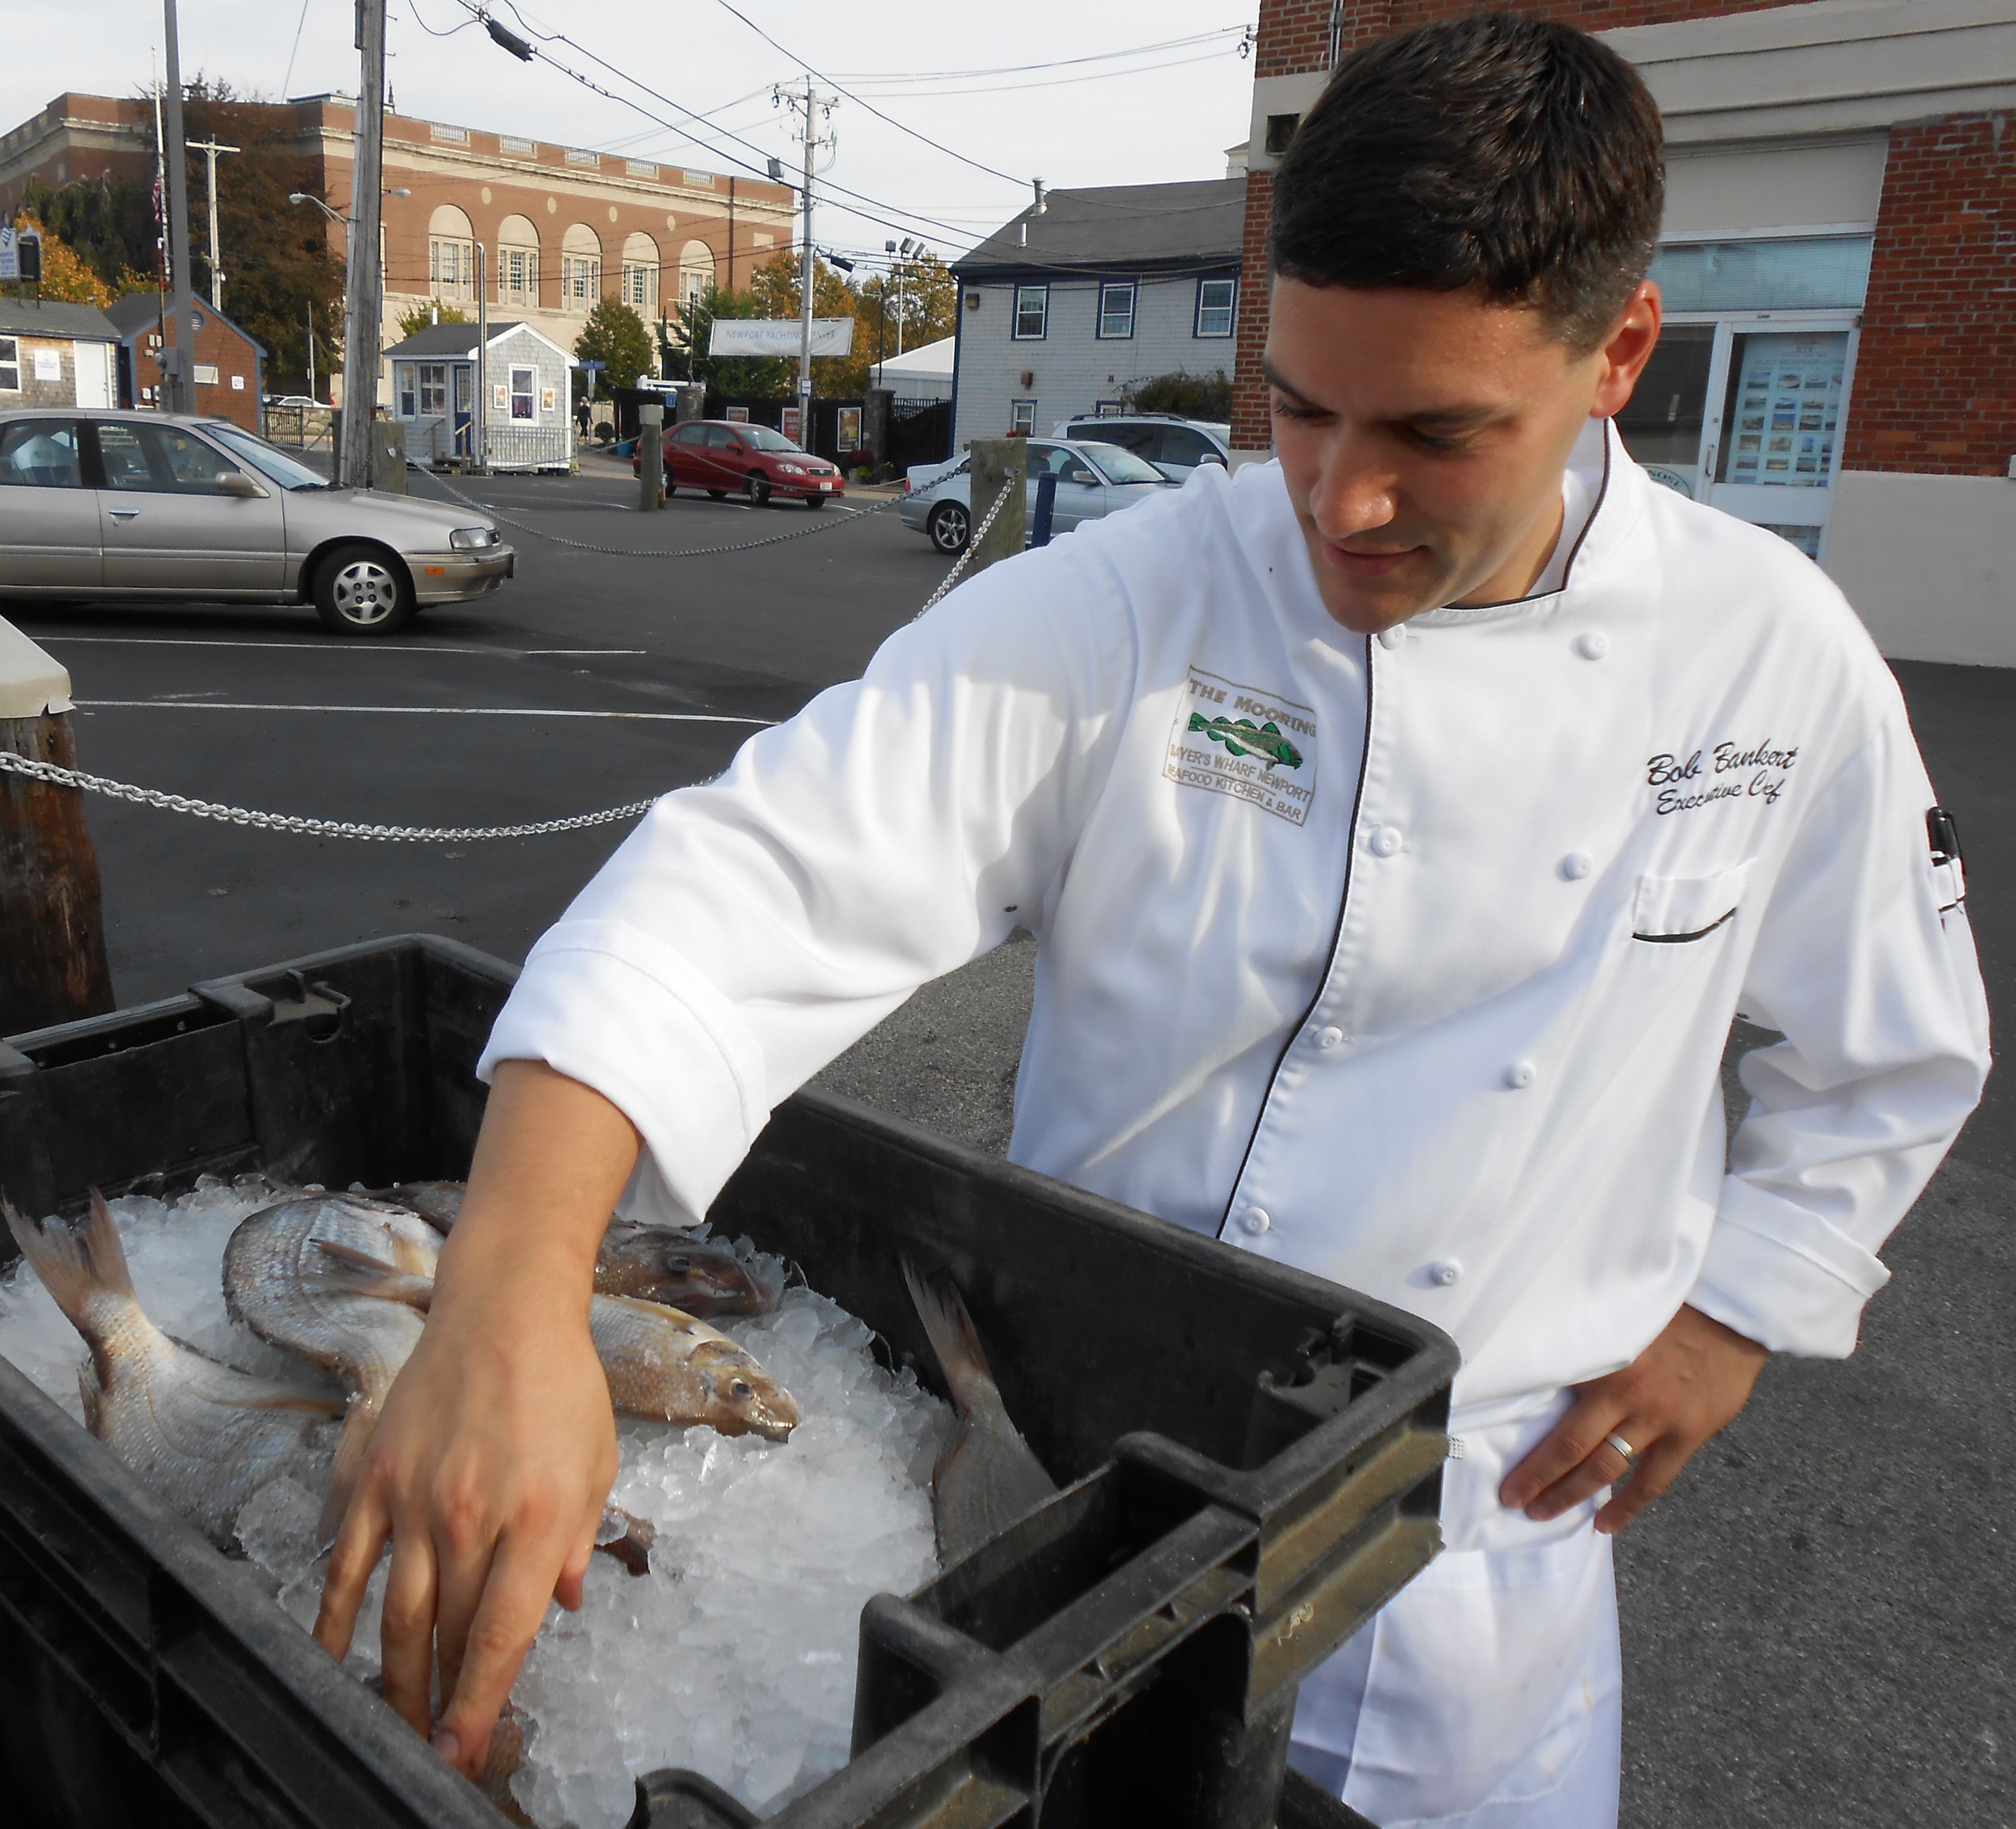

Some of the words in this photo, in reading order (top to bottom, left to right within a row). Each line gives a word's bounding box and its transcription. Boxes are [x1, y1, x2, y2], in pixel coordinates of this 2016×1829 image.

[727, 331, 763, 340] NEWPORT
[1189, 678, 1227, 703] THE
[1214, 756, 1257, 777] WHARF
[1257, 769, 1310, 802] NEWPORT
[1647, 750, 1702, 785] Bob
[1215, 777, 1265, 802] KITCHEN
[1265, 798, 1272, 807] &
[1276, 801, 1302, 819] BAR
[1656, 783, 1742, 815] Executive
